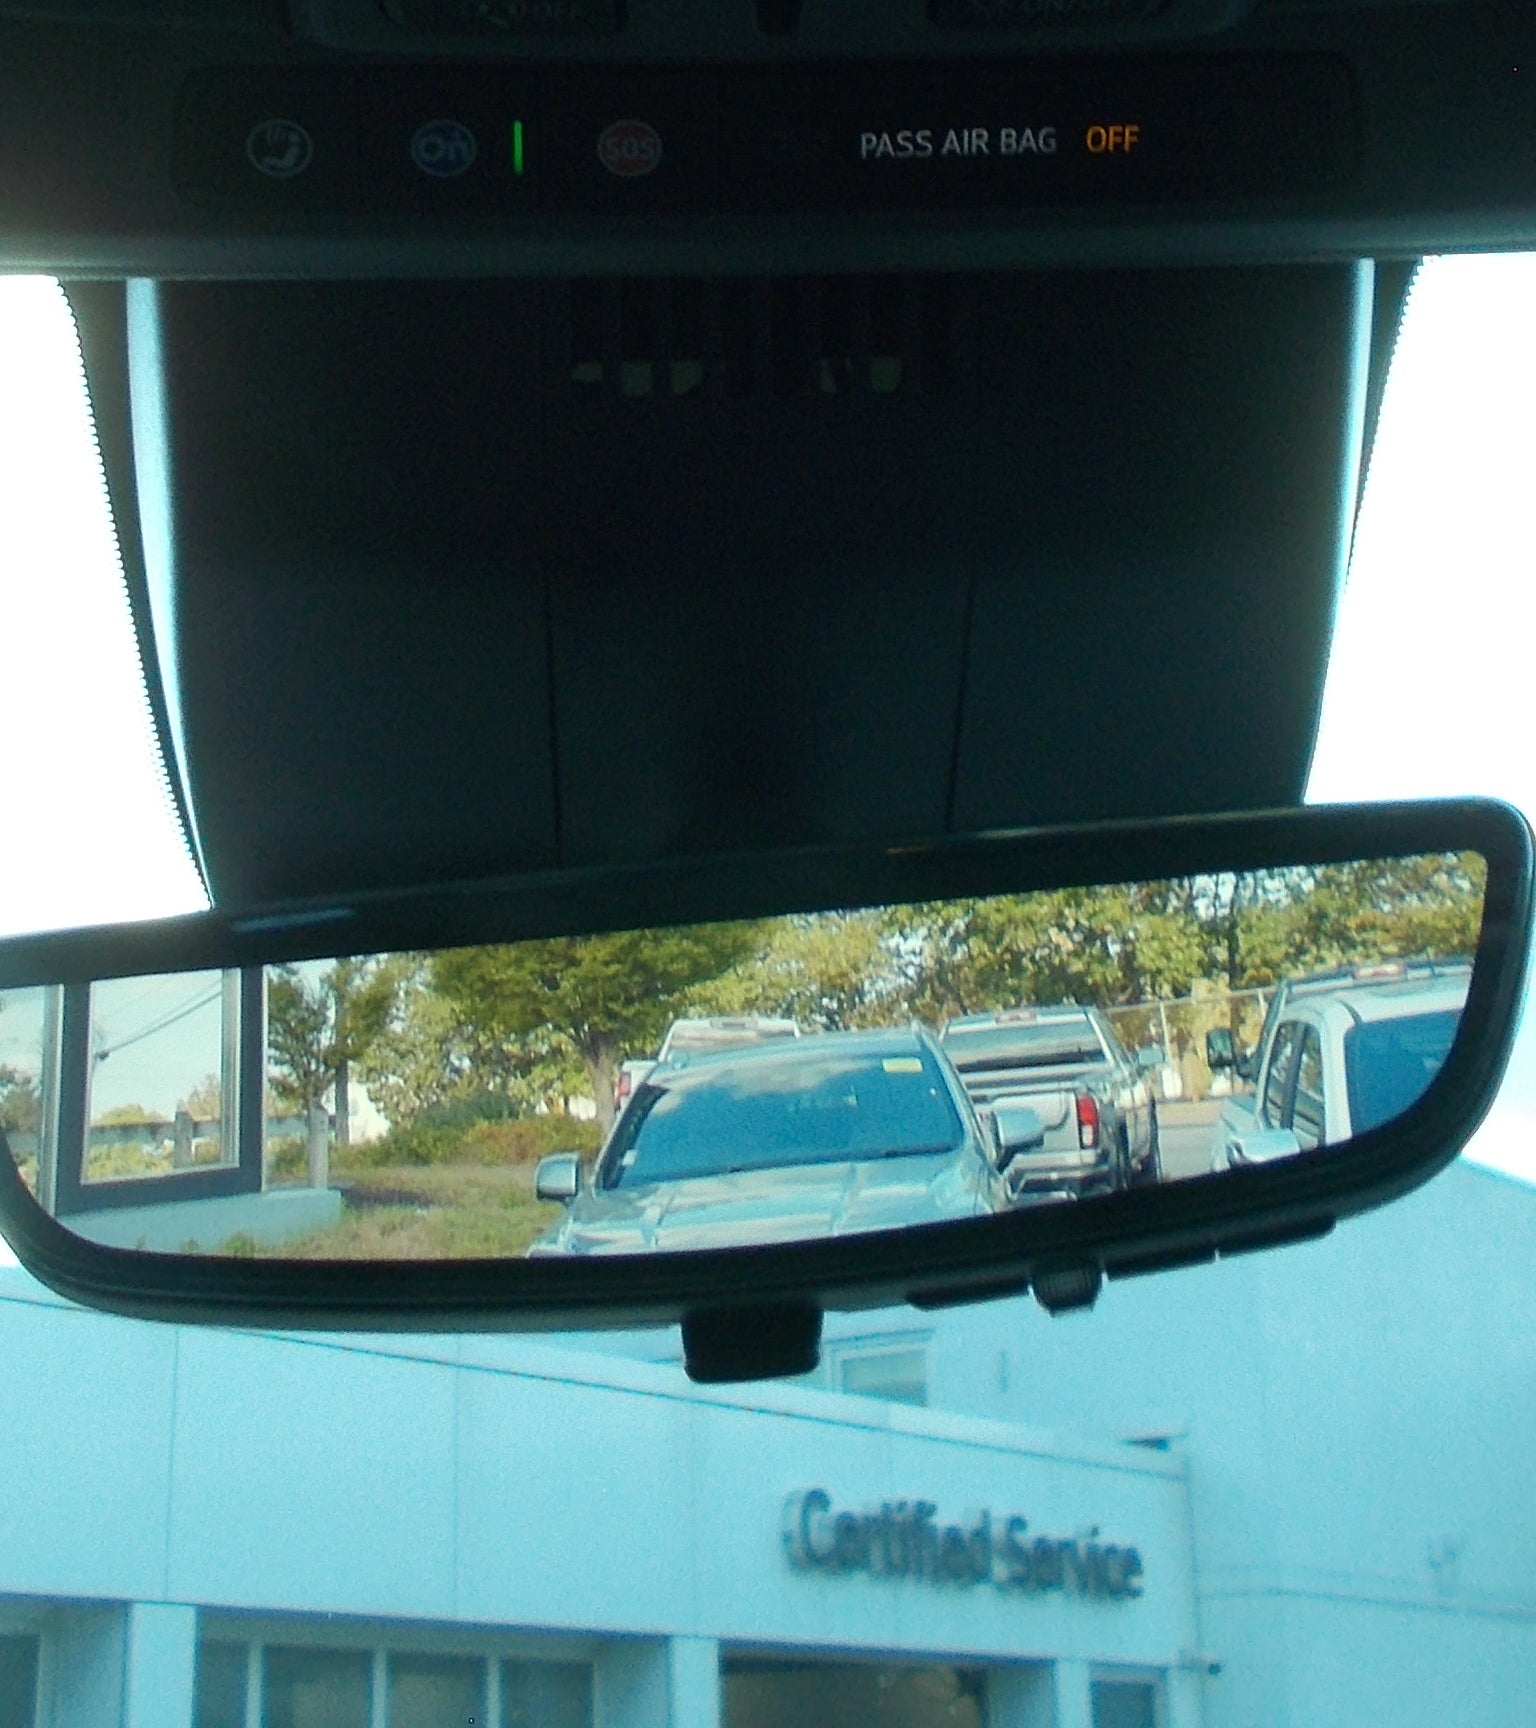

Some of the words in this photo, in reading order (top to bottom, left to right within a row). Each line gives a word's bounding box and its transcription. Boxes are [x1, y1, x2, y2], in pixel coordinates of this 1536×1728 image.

[606, 135, 656, 159] SOS
[859, 130, 934, 160] PASS
[940, 127, 991, 157] AIR
[999, 126, 1058, 155] BAG
[1084, 123, 1142, 154] OFF
[785, 1488, 992, 1588] Certified
[994, 1515, 1145, 1598] Service
